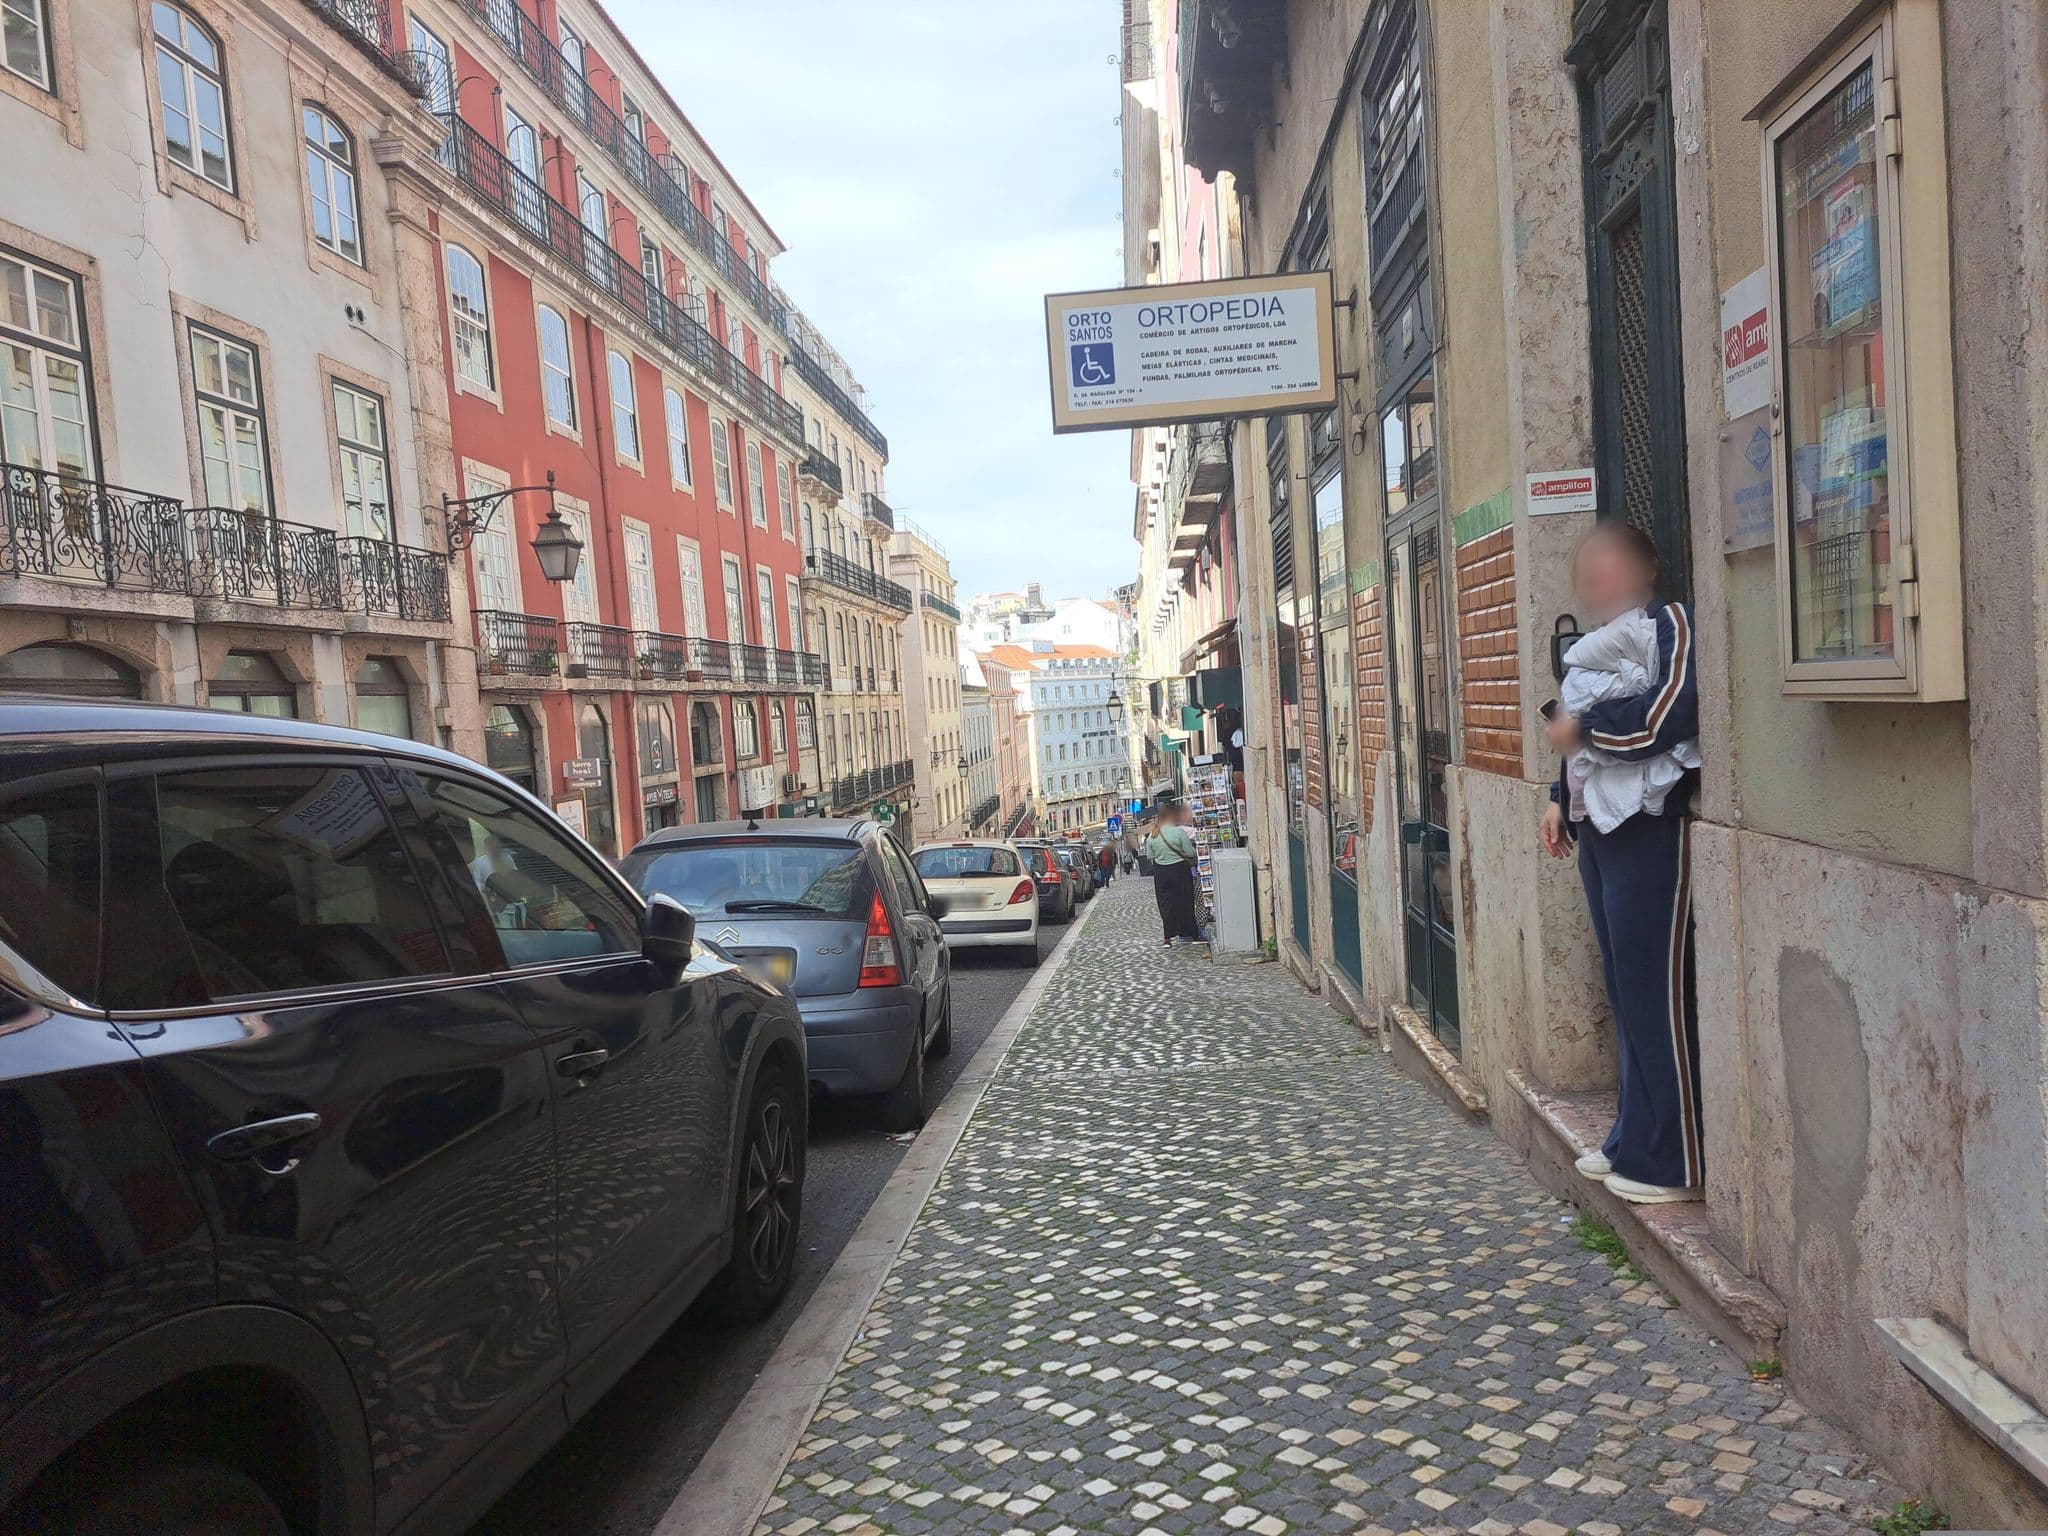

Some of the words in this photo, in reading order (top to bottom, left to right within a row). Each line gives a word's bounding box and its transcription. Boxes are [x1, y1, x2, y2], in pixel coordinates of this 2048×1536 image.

[1068, 311, 1112, 327] ORTO
[1138, 296, 1284, 328] ORTOPEDIA
[1069, 326, 1113, 342] SANTOS
[1190, 326, 1219, 335] ARTIGOS
[1141, 350, 1170, 359] CADEIRA
[1185, 346, 1210, 354] RODAS,
[1213, 342, 1253, 352] AUXILIARES
[1256, 341, 1265, 349] DE
[1268, 338, 1297, 348] MARCHA
[1141, 362, 1162, 370] MEIAS
[1209, 356, 1233, 365] CINTAS
[1236, 352, 1278, 362] MEDICINAIS,
[1142, 373, 1171, 382] FUNDAS,
[1174, 370, 1211, 380] PALMILHAS
[1266, 364, 1282, 372] ETC.
[1548, 481, 1590, 493] amplifon
